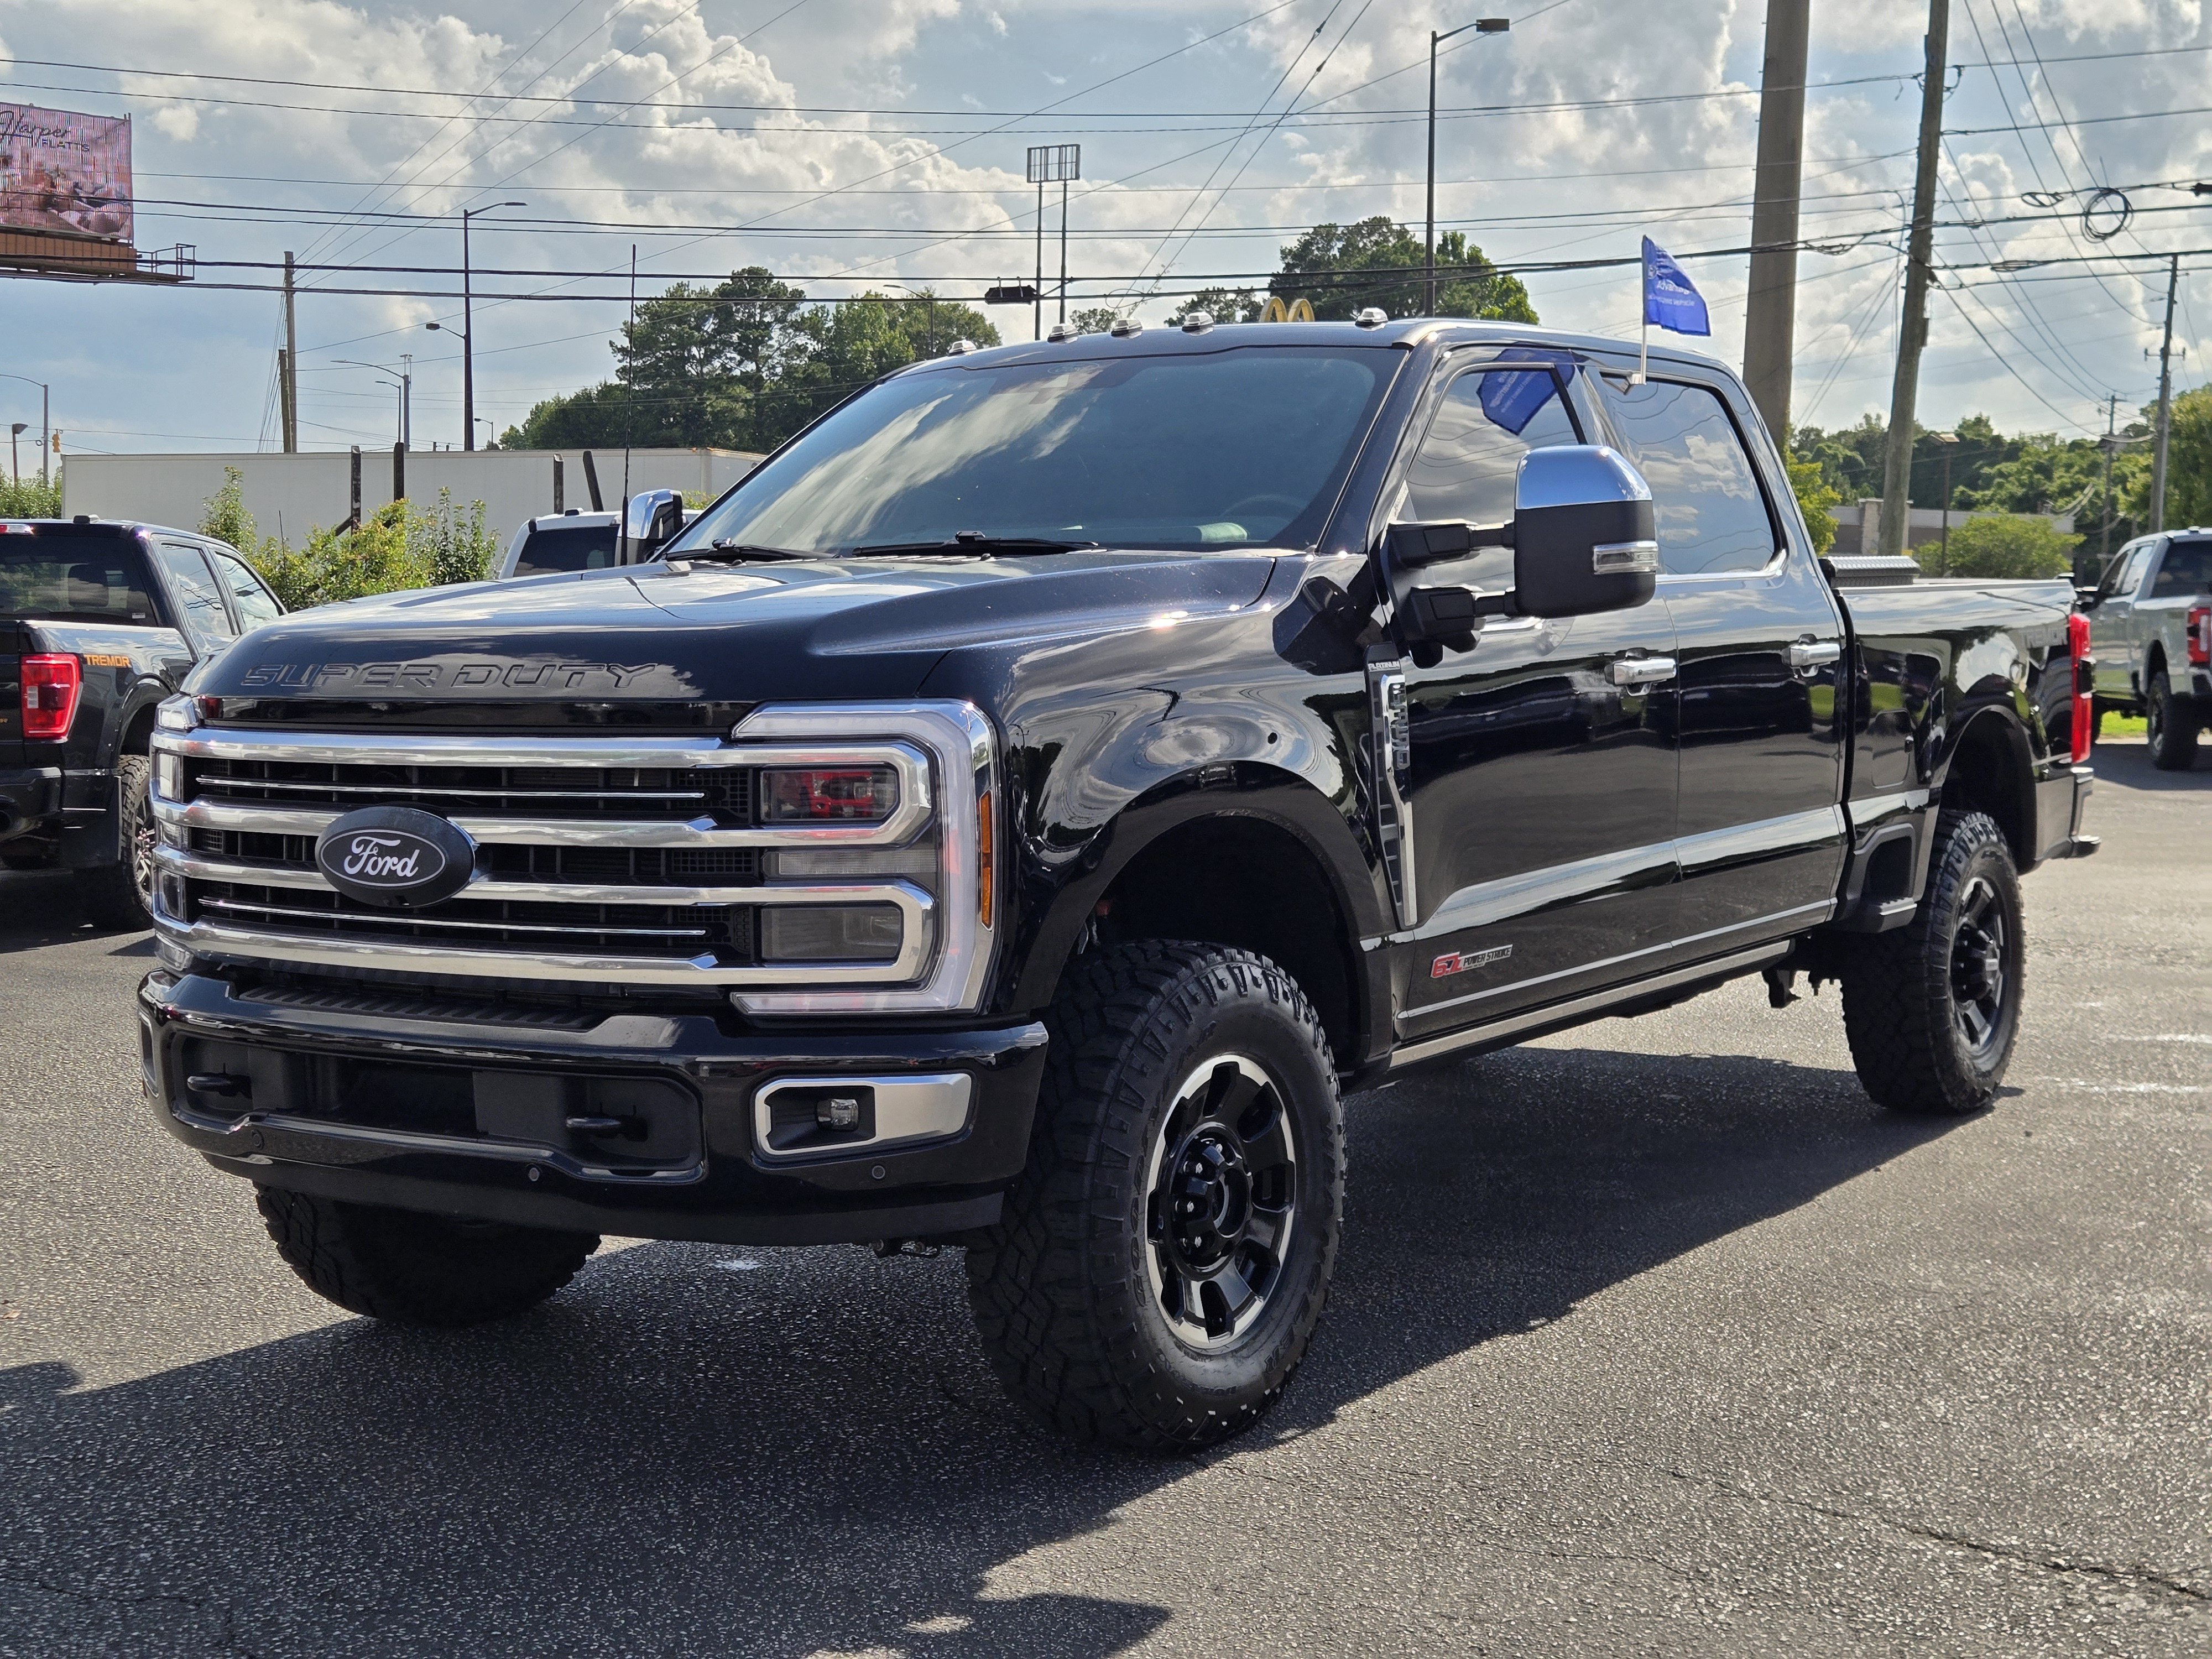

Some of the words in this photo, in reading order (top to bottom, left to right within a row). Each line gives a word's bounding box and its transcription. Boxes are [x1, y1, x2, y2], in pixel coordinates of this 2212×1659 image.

[85, 654, 131, 667] TREMOR
[1368, 661, 1400, 672] PLATINUM
[240, 664, 444, 688] SUPER
[453, 663, 659, 689] DUTY
[344, 836, 420, 877] Ford
[1463, 953, 1486, 967] POWER
[1486, 948, 1511, 961] STROKE
